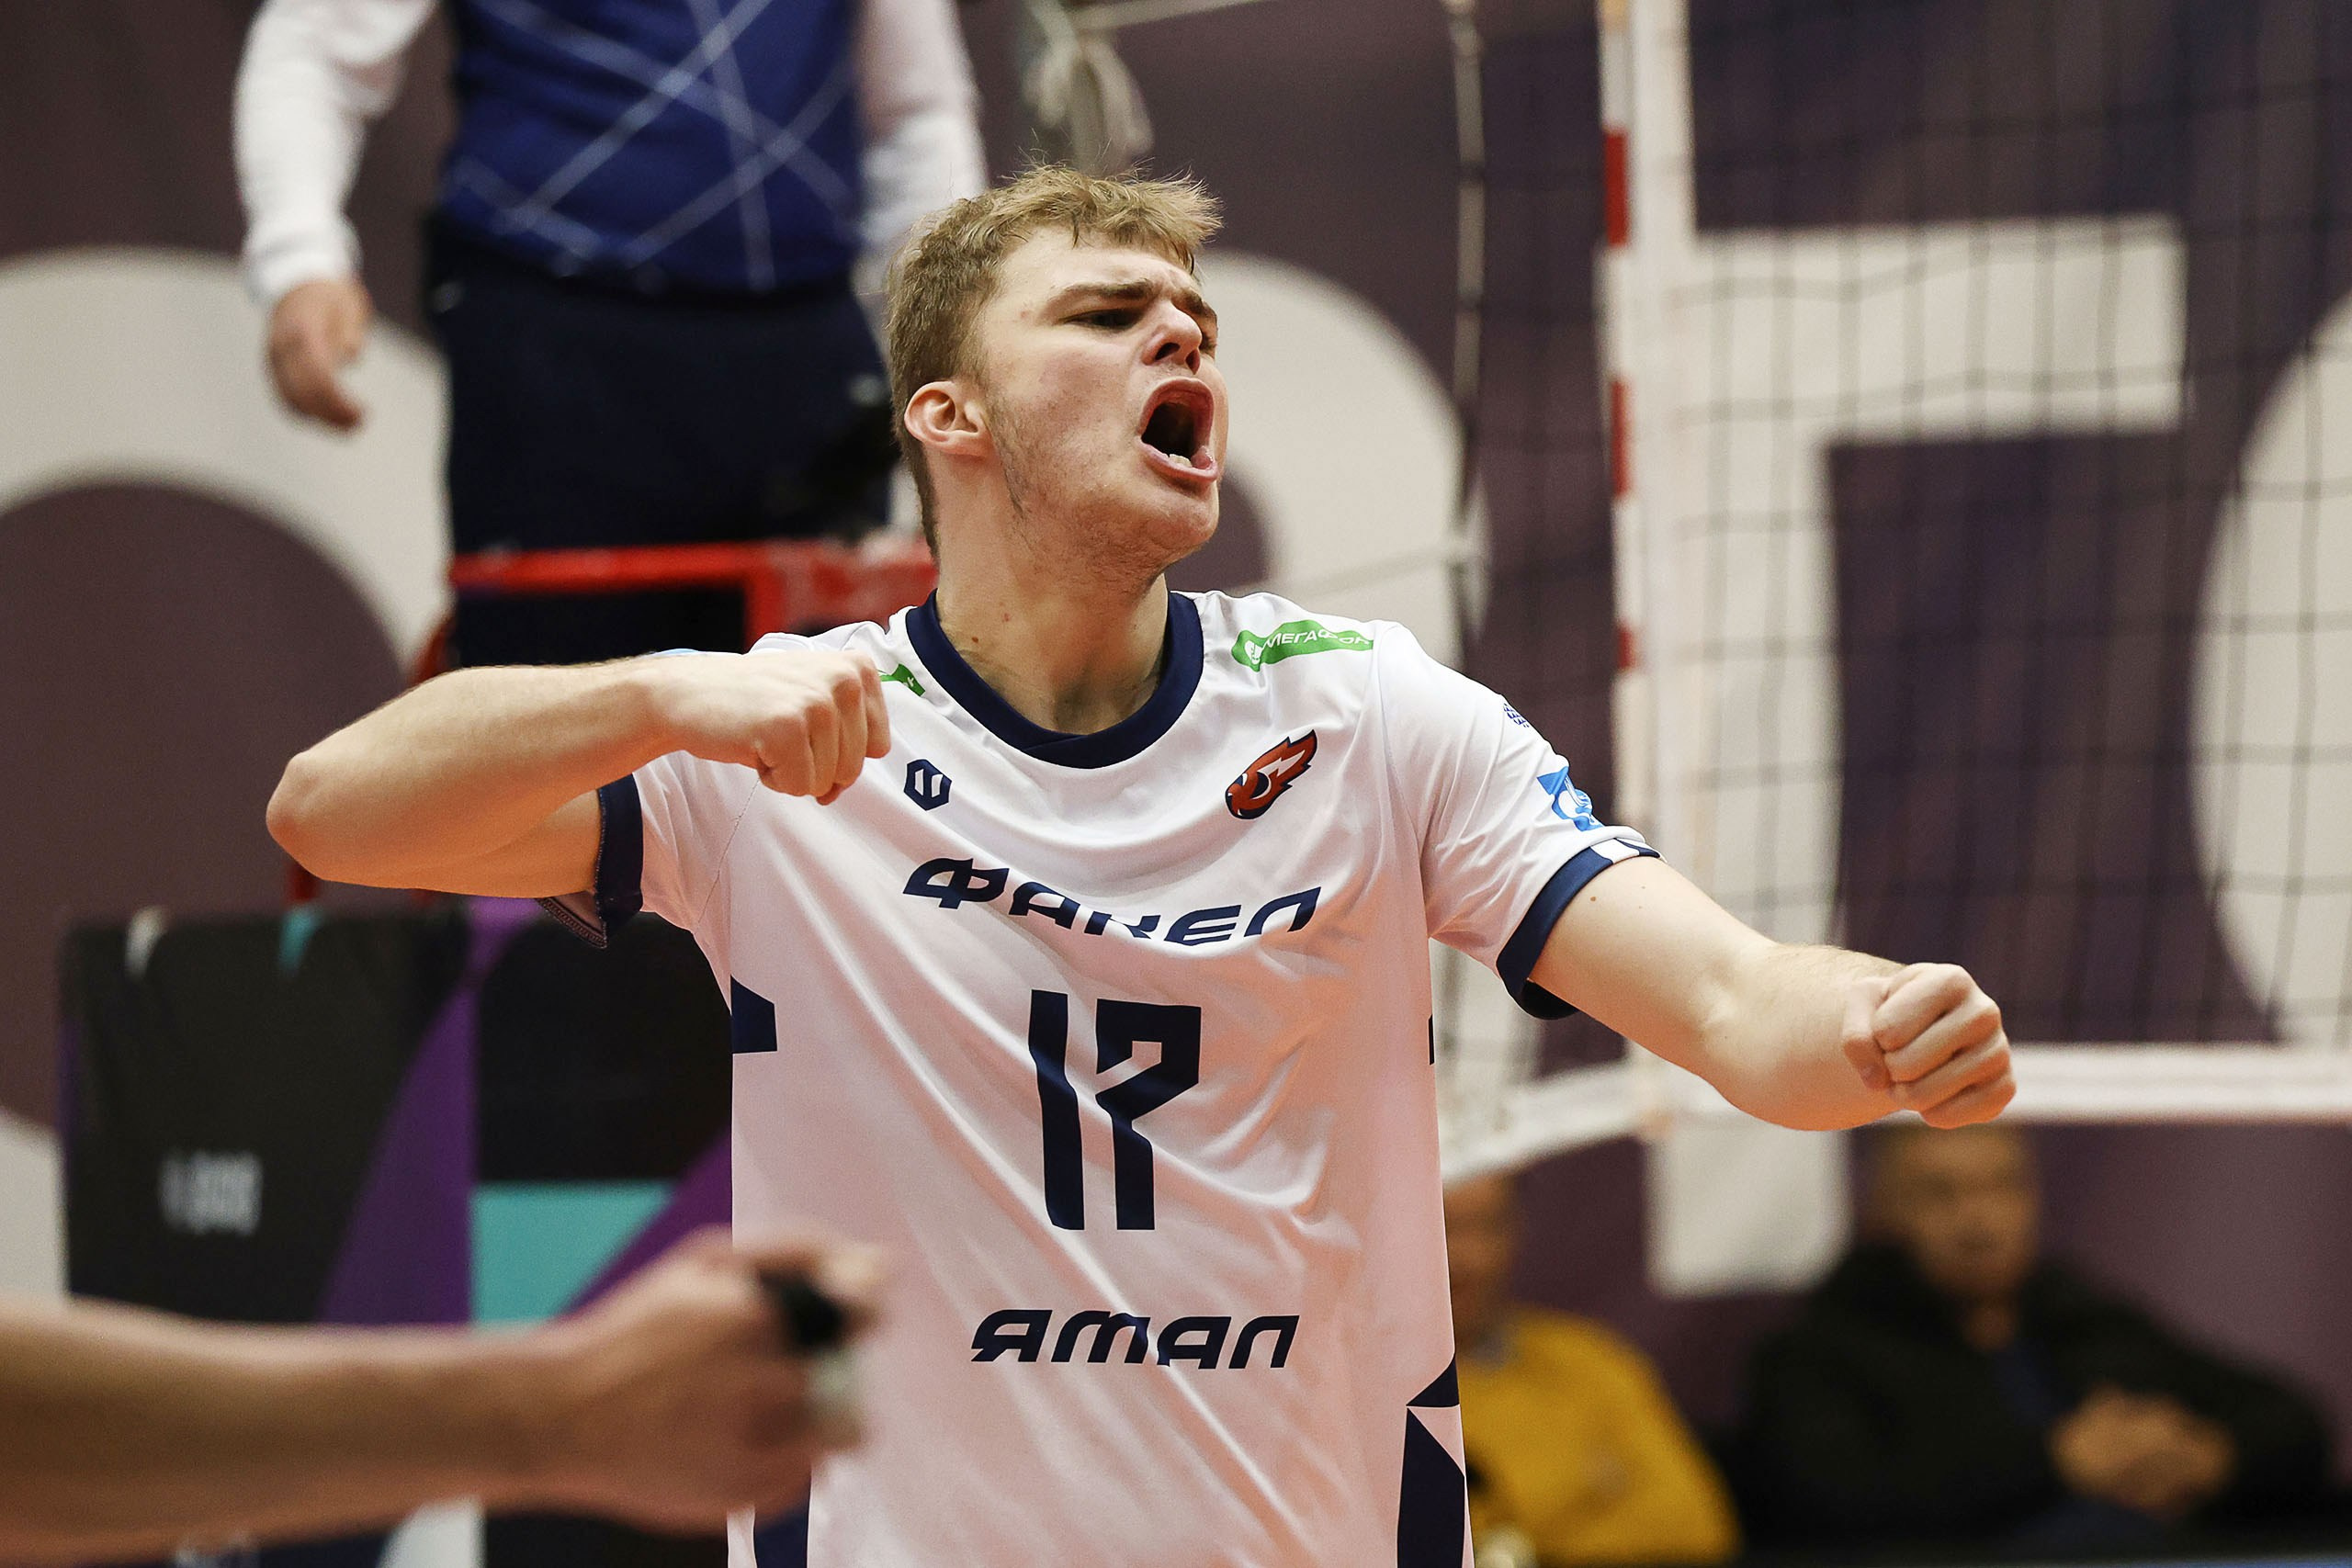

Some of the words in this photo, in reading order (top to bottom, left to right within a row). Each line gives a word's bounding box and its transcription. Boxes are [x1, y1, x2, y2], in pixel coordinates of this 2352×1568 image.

[902, 857, 1321, 946] ФАКЕЛ
[1028, 988, 1202, 1231] 17
[970, 1309, 1300, 1370] ЯМАЛ
